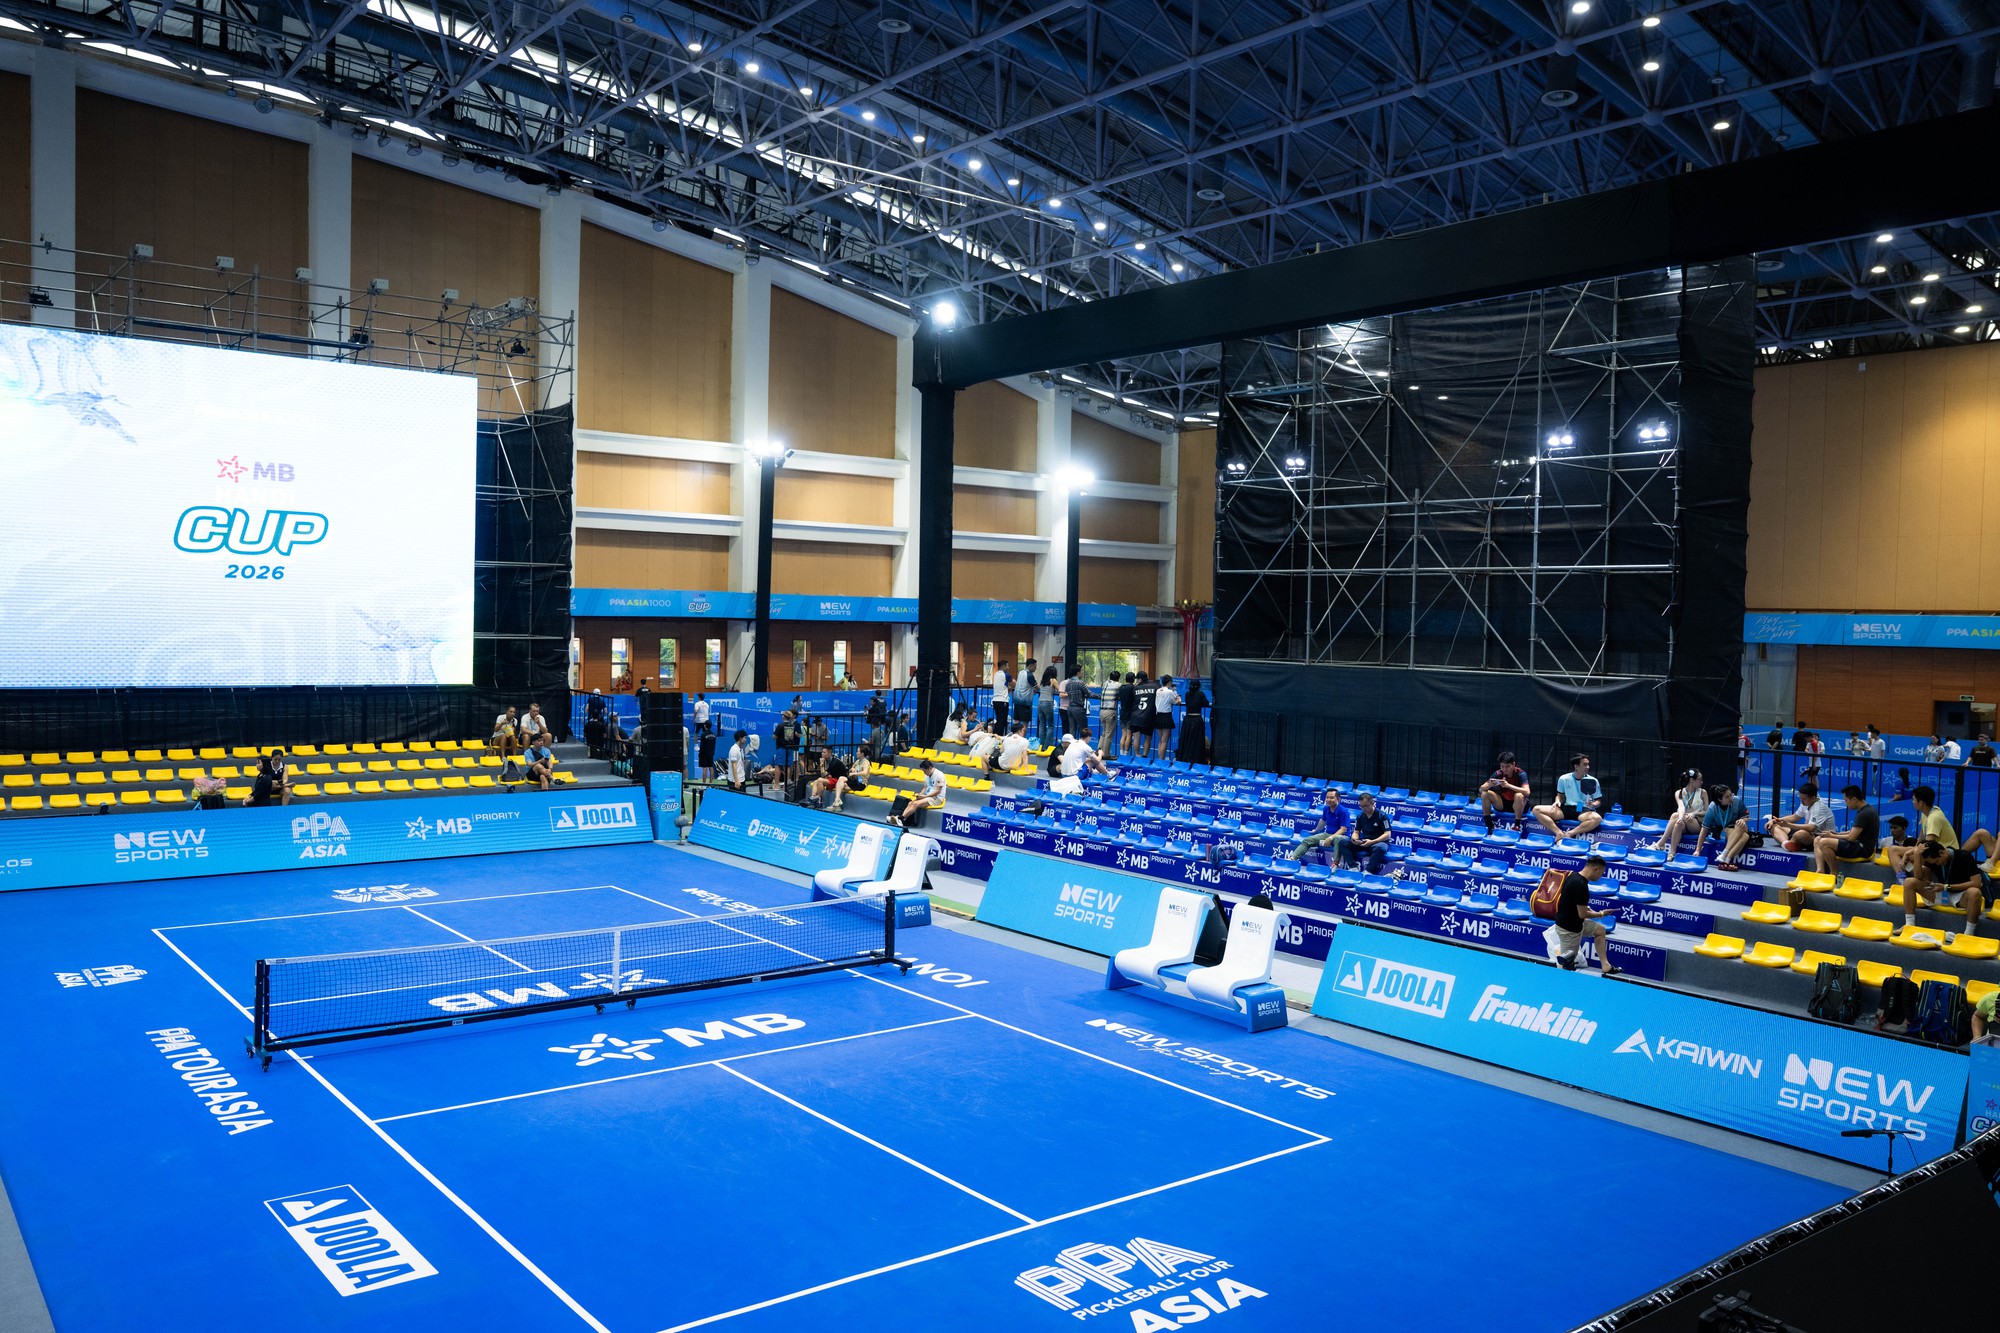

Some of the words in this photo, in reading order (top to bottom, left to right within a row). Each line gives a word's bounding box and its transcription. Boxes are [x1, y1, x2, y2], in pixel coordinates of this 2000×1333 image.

[253, 461, 295, 482] MB
[173, 505, 329, 556] CUP
[224, 564, 285, 580] 2026
[688, 602, 711, 612] CUP
[820, 602, 851, 610] NEW
[1853, 623, 1901, 633] NEW
[1138, 697, 1148, 710] 5
[1091, 790, 1103, 800] MB
[1134, 797, 1146, 806] MB
[661, 802, 680, 811] CUP
[1003, 801, 1015, 811] MB
[1179, 803, 1193, 813] MB
[1380, 805, 1396, 816] MB
[582, 806, 633, 826] JOOLA
[1085, 815, 1098, 826] MB
[1228, 810, 1242, 820] MB
[1243, 810, 1262, 818] PRIORITY
[1440, 813, 1457, 824] MB
[291, 812, 351, 839] PPA
[436, 817, 472, 835] MB
[474, 811, 520, 822] PRIORITY
[699, 818, 739, 833] PADDLETEK
[956, 820, 971, 834] MB
[972, 820, 991, 829] PRIORITY
[1130, 823, 1143, 833] MB
[1280, 817, 1295, 829] MB
[1296, 818, 1317, 826] PRIORITY
[114, 828, 205, 849] NEW
[758, 823, 772, 838] FPT
[772, 827, 789, 844] Play
[1009, 830, 1025, 845] MB
[1026, 831, 1048, 840] PRIORITY
[1178, 830, 1192, 842] MB
[1193, 831, 1212, 839] PRIORITY
[1597, 833, 1624, 841] PRIORITY
[1229, 839, 1244, 851] MB
[1245, 840, 1266, 849] PRIORITY
[1395, 836, 1413, 848] MB
[1414, 836, 1438, 845] PRIORITY
[115, 846, 209, 863] SPORTS
[299, 844, 347, 859] ASIA
[938, 848, 955, 866] MB
[957, 849, 982, 861] PRIORITY
[1067, 843, 1084, 857] MB
[1085, 843, 1109, 851] PRIORITY
[1460, 846, 1479, 859] MB
[1481, 846, 1506, 855] PRIORITY
[1130, 855, 1149, 869] MB
[1151, 855, 1177, 865] PRIORITY
[1531, 856, 1551, 869] MB
[1553, 858, 1580, 866] PRIORITY
[1733, 853, 1757, 867] MB
[1760, 853, 1791, 863] PRIORITY
[1200, 867, 1221, 884] MB
[1223, 868, 1251, 880] PRIORITY
[1408, 871, 1428, 884] MB
[1429, 871, 1455, 880] PRIORITY
[1607, 868, 1629, 882] MB
[1631, 869, 1661, 879] PRIORITY
[1278, 883, 1301, 900] MB
[1303, 885, 1334, 897] PRIORITY
[1479, 883, 1500, 896] MB
[1502, 883, 1529, 893] PRIORITY
[1690, 881, 1714, 895] MB
[1716, 882, 1748, 892] PRIORITY
[1059, 882, 1122, 913] NEW
[904, 905, 925, 913] NEW
[1169, 903, 1188, 913] NEW
[1365, 900, 1390, 919] MB
[1393, 902, 1428, 915] PRIORITY
[1054, 903, 1115, 929] SPORTS
[1639, 909, 1664, 925] MB
[1667, 911, 1699, 921] PRIORITY
[1241, 920, 1263, 931] NEW
[1462, 918, 1491, 938] MB
[1494, 921, 1533, 935] PRIORITY
[1276, 925, 1303, 945] MB
[1307, 926, 1336, 938] PRIOR
[1609, 943, 1652, 959] PRIORITY
[1371, 966, 1446, 1011] JOOLA
[428, 981, 571, 1012] MB
[1257, 1000, 1280, 1011] NEW
[1257, 1007, 1281, 1017] SPORTS
[662, 1012, 807, 1048] MB
[1084, 1018, 1183, 1047] NEW
[1175, 1047, 1336, 1100] SPORTS
[1656, 1036, 1763, 1079] KAIWIN
[166, 1048, 238, 1098] TOUR
[1783, 1053, 1935, 1114] NEW
[197, 1091, 274, 1136] ASIA
[1777, 1087, 1928, 1142] SPORTS
[304, 1218, 416, 1289] JOOLA
[1014, 1237, 1216, 1311] PPA
[1071, 1278, 1184, 1321] PICKLEBALL
[1179, 1260, 1234, 1281] TOUR
[1130, 1277, 1269, 1333] ASIA
